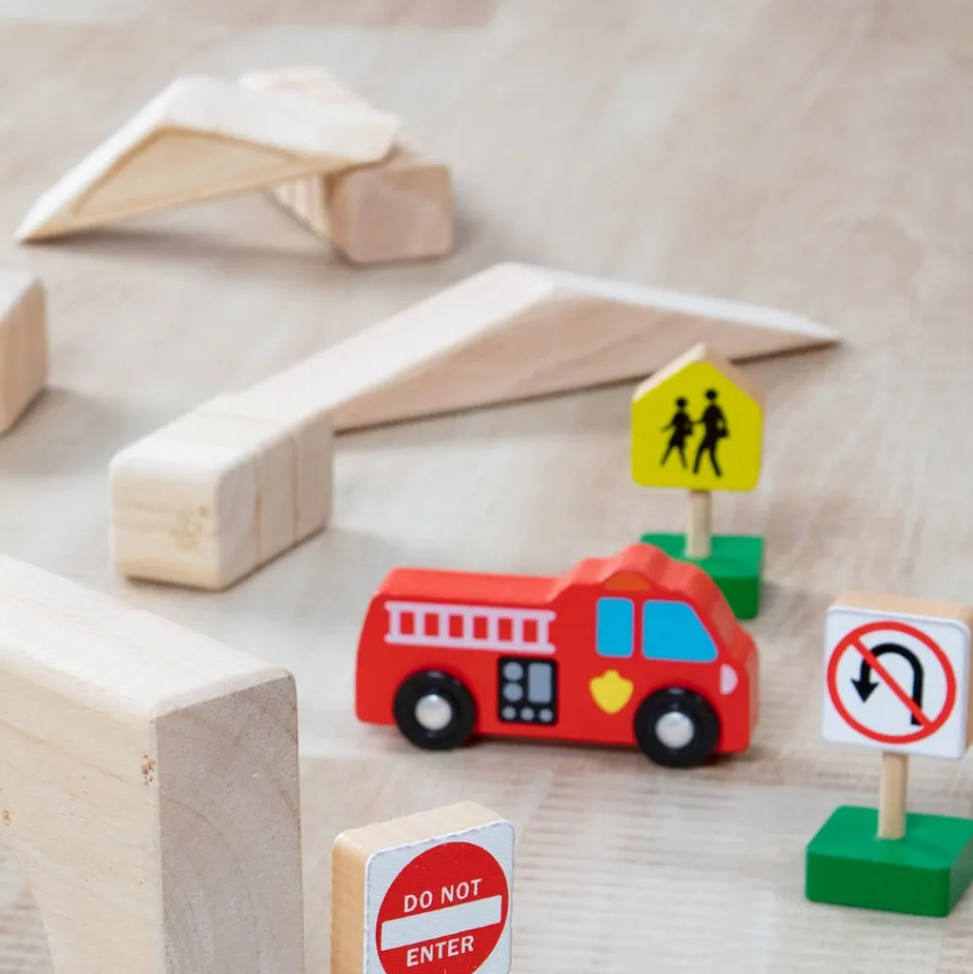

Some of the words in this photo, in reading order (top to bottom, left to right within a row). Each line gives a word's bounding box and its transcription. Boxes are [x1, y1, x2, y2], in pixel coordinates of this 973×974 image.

[403, 890, 433, 913] DO
[441, 878, 482, 904] NOT
[406, 935, 475, 967] ENTER
